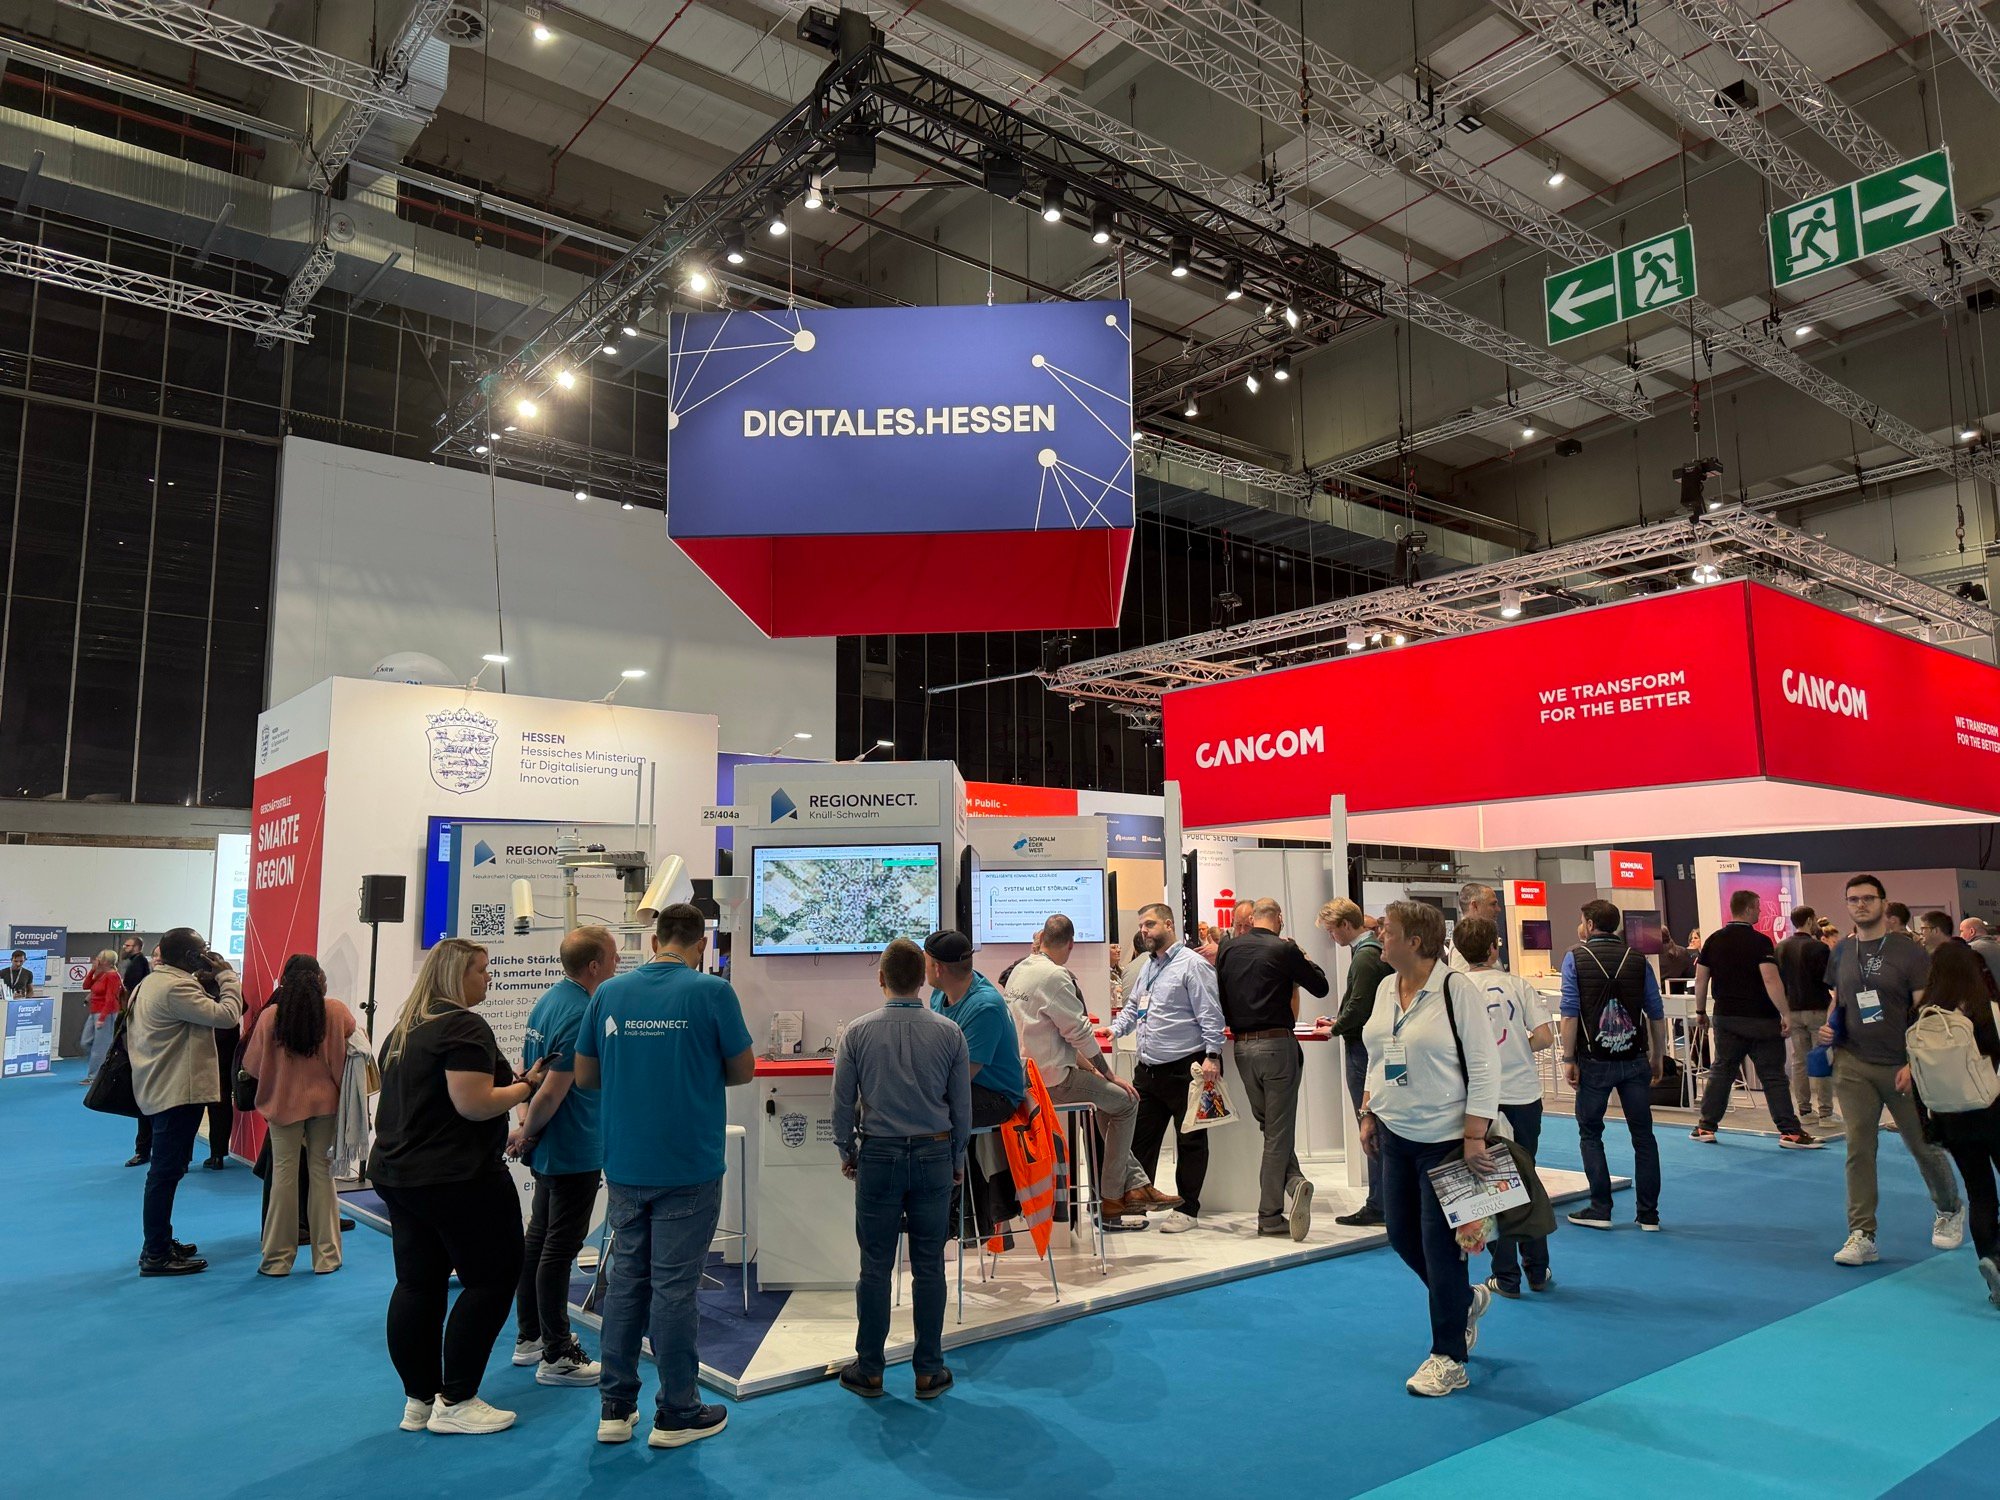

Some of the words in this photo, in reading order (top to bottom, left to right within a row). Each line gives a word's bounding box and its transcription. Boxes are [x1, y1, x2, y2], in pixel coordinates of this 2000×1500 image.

[744, 404, 1056, 437] DIGITALES.HESSEN
[1539, 688, 1568, 704] WE
[1572, 670, 1686, 700] TRANSFORM
[1782, 668, 1869, 721] CANCOM
[1540, 706, 1576, 724] FOR
[1580, 701, 1615, 718] THE
[1620, 690, 1691, 713] BETTER
[1955, 715, 1966, 729] WE
[1966, 719, 1999, 737] TRANSFORM
[522, 731, 565, 744] HESSEN
[1957, 732, 1969, 745] FOR
[1969, 736, 1981, 749] THE
[521, 745, 582, 759] Hessisches
[585, 750, 646, 765] Ministerium
[1195, 725, 1325, 769] CANCOM
[520, 759, 536, 769] für
[539, 760, 618, 777] Digitalisierung
[520, 773, 579, 786] Innovation
[809, 793, 919, 808] REGIONNECT.
[975, 798, 1001, 808] Public
[703, 811, 740, 819] 25/404a
[809, 810, 880, 819] Knüll-Schwalm
[258, 813, 300, 852] SMARTE
[255, 854, 295, 890] REGION
[15, 931, 58, 941] Formcycle
[489, 956, 524, 965] dliche
[503, 970, 542, 978] smarte
[505, 1011, 531, 1019] Lighti
[624, 1020, 689, 1030] REGIONNECT.
